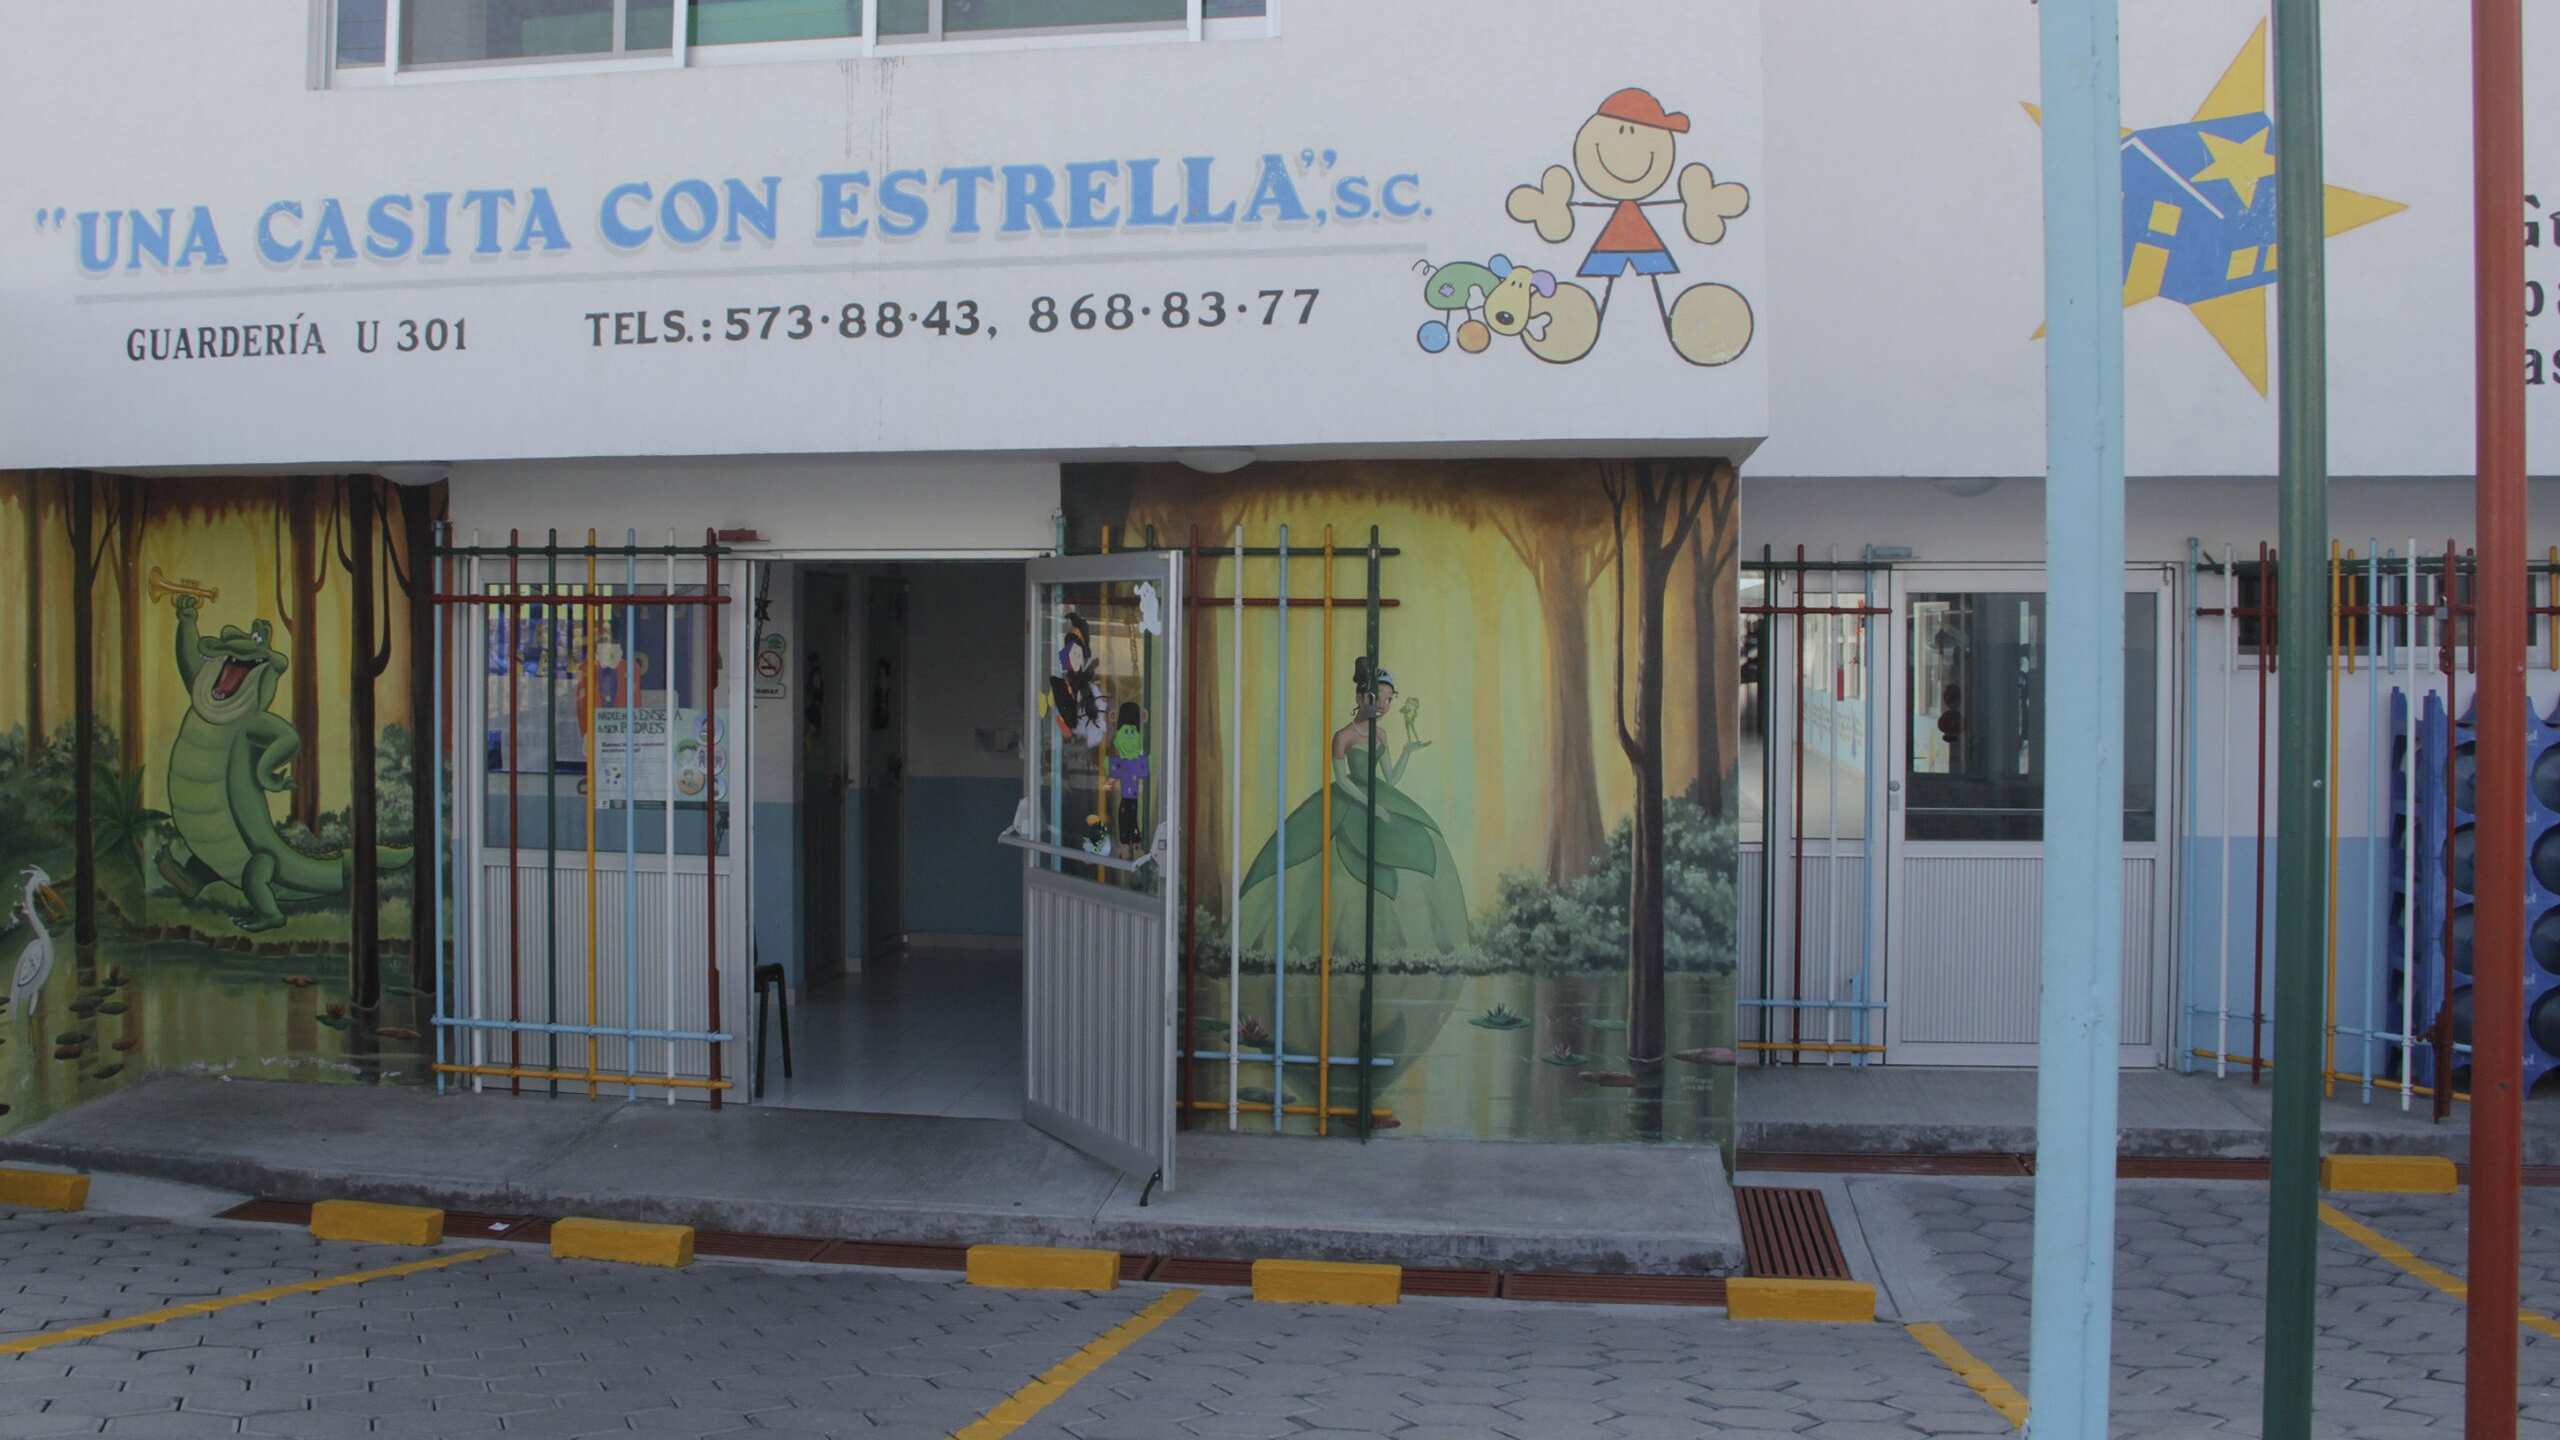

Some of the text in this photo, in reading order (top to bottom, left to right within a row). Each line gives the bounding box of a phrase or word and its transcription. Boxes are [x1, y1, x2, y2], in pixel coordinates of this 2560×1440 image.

[256, 187, 571, 264] CASITA
[600, 175, 782, 249] CON
[126, 312, 326, 362] GUARDERÍA
[357, 320, 379, 354] U
[397, 318, 467, 352] 301
[620, 721, 665, 734] PDRES
[639, 708, 682, 721] ENSEA
